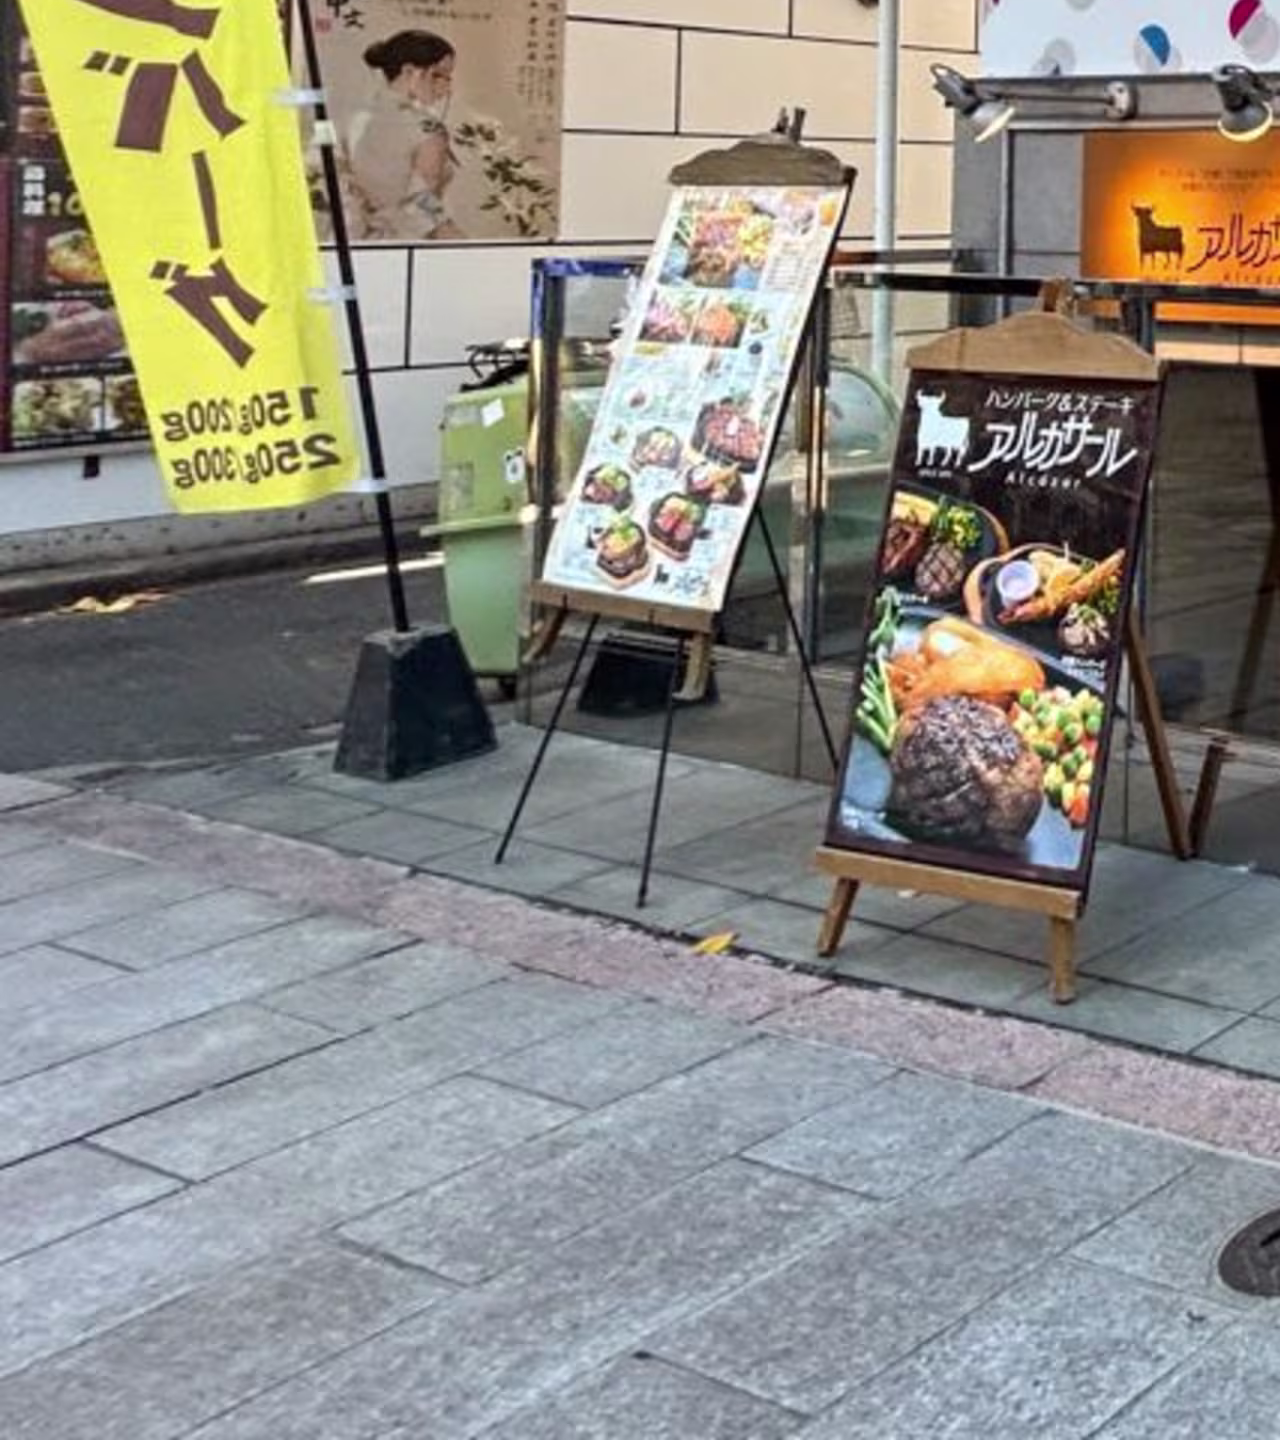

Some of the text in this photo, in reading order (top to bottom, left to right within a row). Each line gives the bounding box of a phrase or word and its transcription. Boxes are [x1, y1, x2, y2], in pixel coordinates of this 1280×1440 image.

[967, 411, 1138, 478] アルカサール
